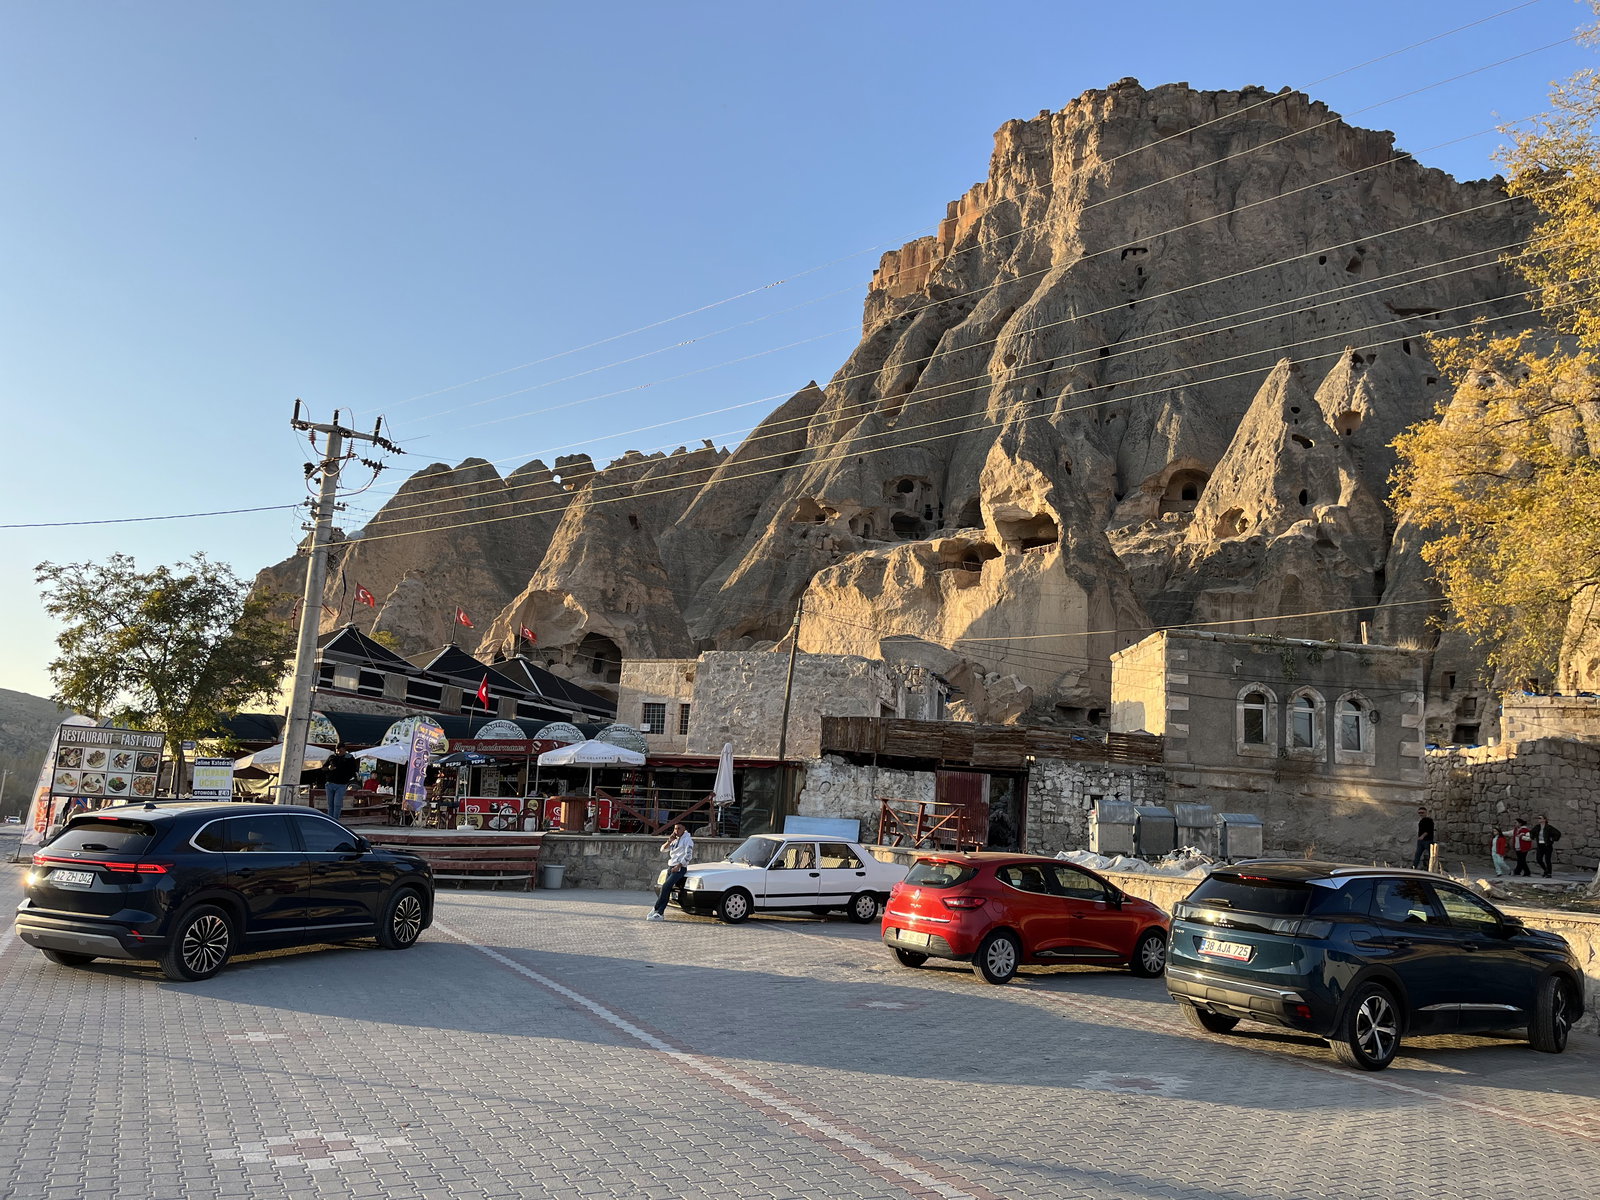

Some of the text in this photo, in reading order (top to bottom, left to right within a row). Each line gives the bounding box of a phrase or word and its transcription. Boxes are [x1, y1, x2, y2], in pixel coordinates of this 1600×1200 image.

[61, 729, 162, 748] RESTAURANT FAST FOOD
[1205, 940, 1249, 957] 38 AJA 725
